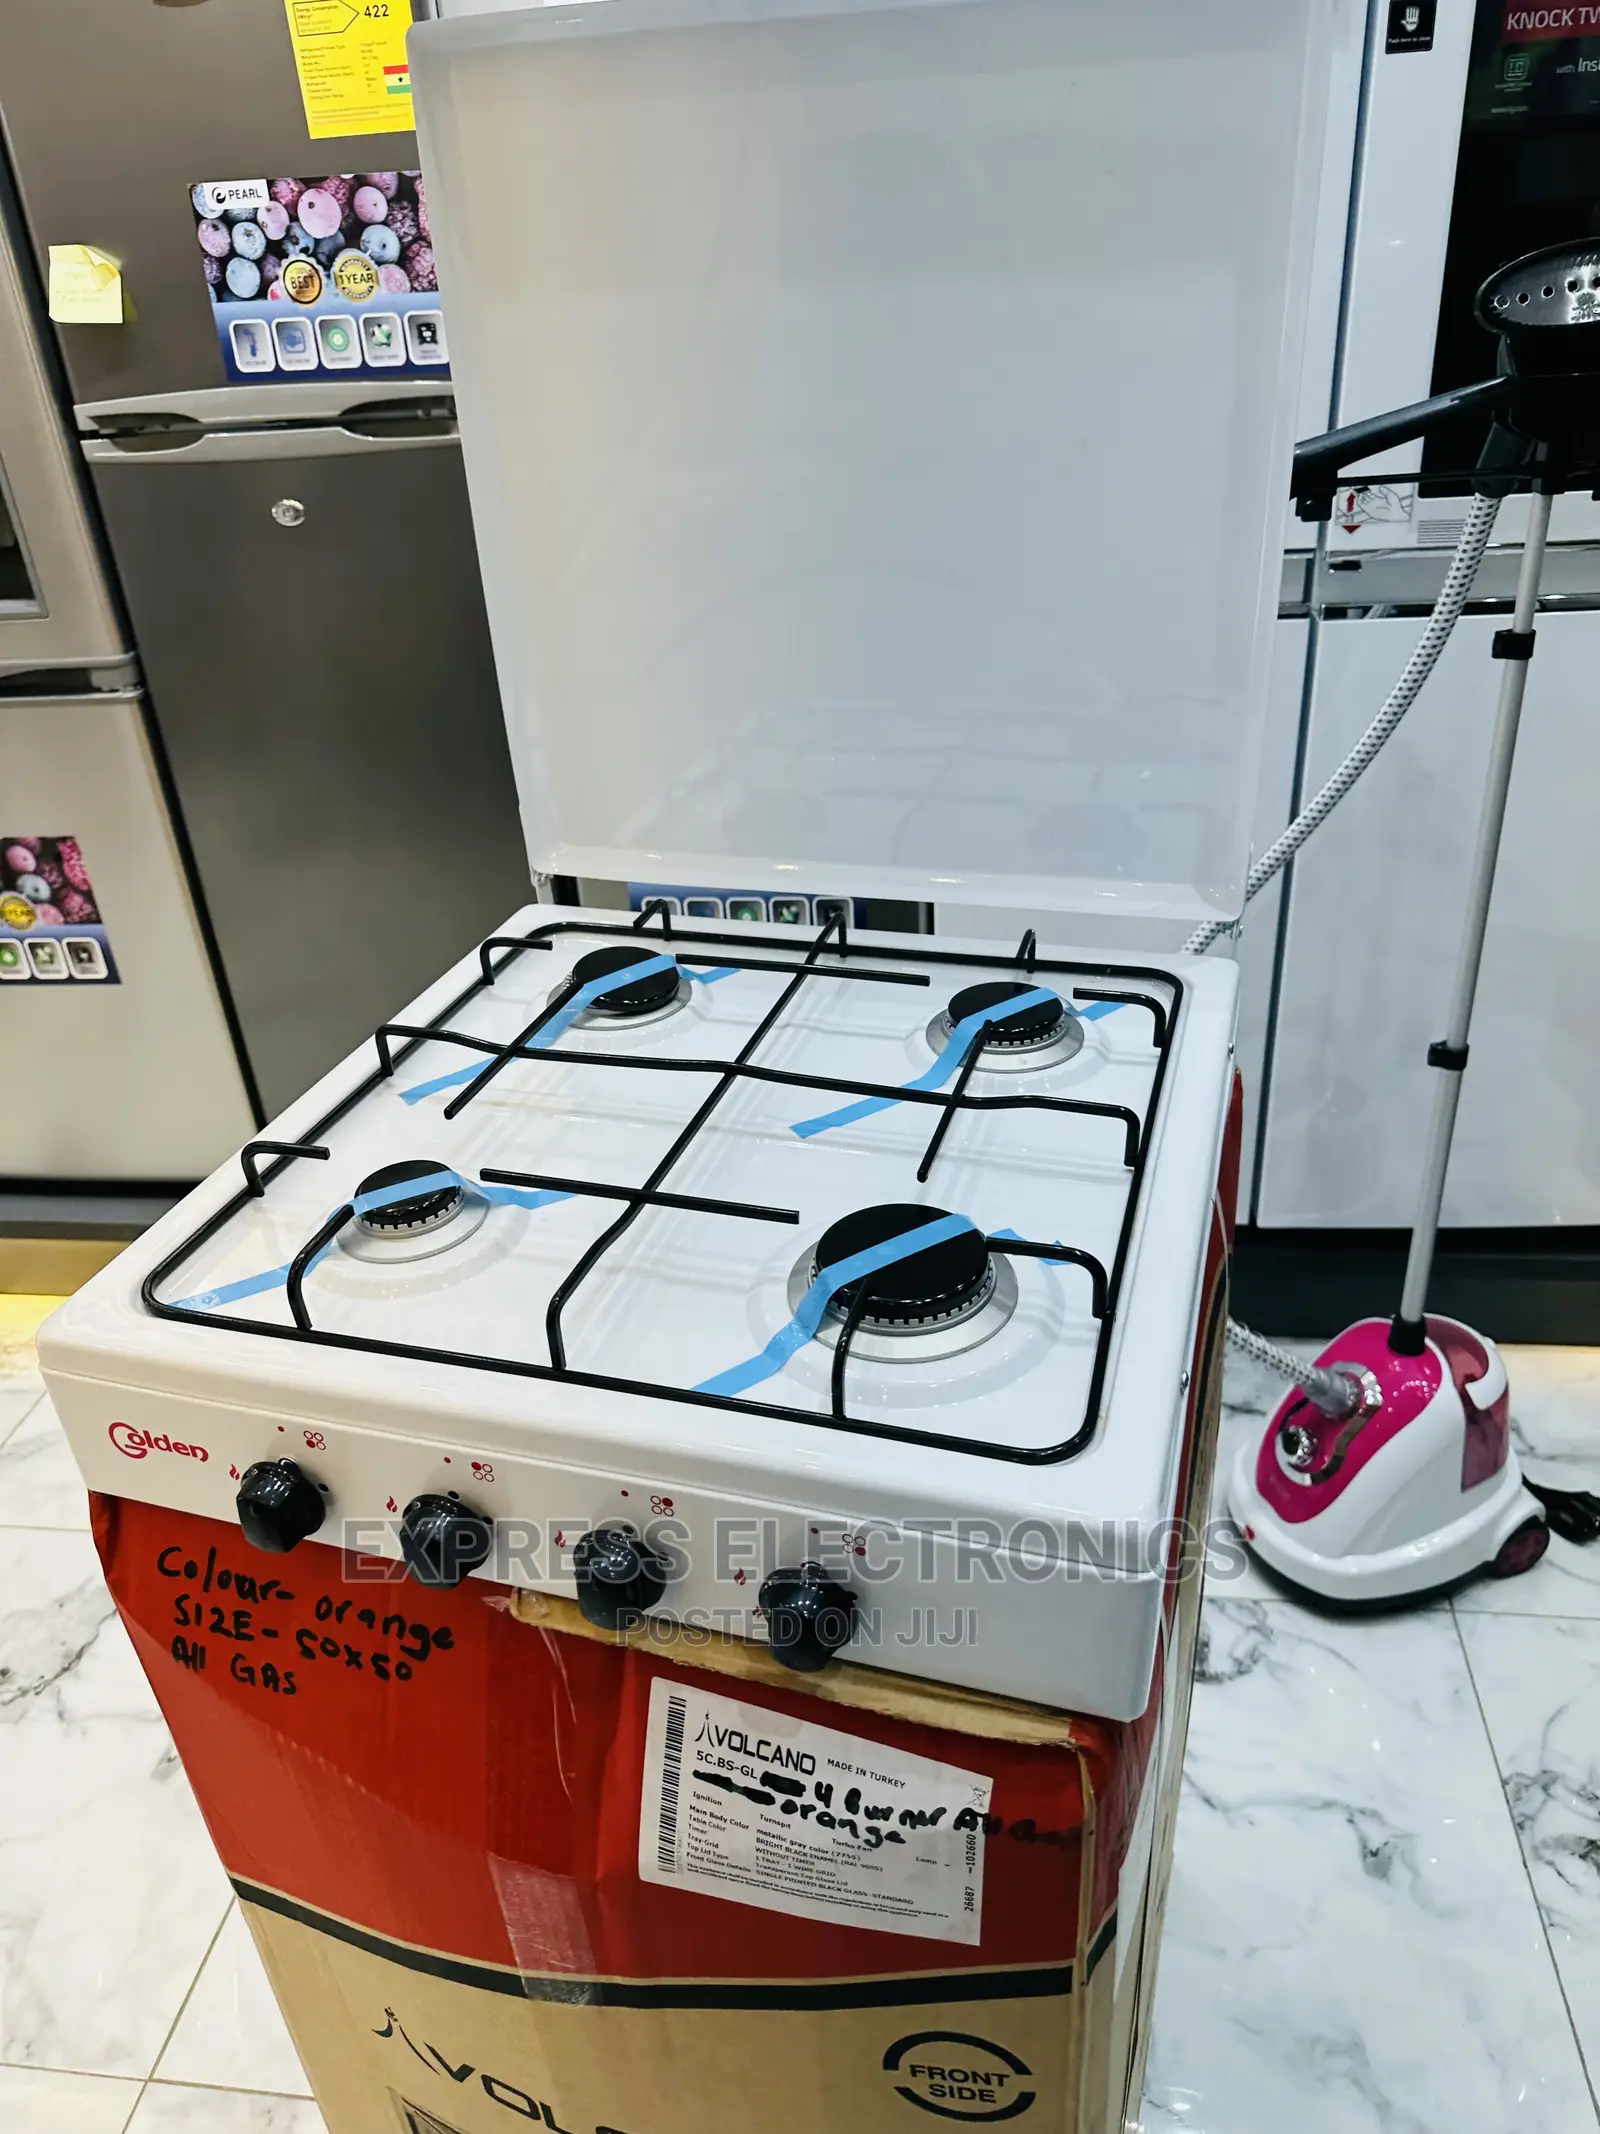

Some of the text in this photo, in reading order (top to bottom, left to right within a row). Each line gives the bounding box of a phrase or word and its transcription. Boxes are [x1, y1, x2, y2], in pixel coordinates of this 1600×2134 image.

[364, 4, 389, 18] 422
[1507, 8, 1575, 30] KNOCK
[1577, 57, 1600, 73] Ins
[228, 188, 263, 200] PEARL
[290, 274, 315, 290] BEST
[108, 1421, 209, 1463] Golden
[315, 1596, 455, 1662] orange
[715, 1725, 816, 1776] VOLCANO
[827, 1757, 906, 1790] MADE IN TURKEY
[692, 1791, 722, 1806] Ignition
[689, 1804, 750, 1830] Main Body Color
[689, 1814, 726, 1832] Table Color
[760, 1813, 791, 1829] Turnspit
[688, 1823, 708, 1835] Timer
[687, 1842, 699, 1852] Top
[700, 1847, 711, 1855] Lid
[756, 1837, 783, 1850] BRIGHT
[785, 1846, 808, 1857] BLACK
[809, 1845, 830, 1854] color
[832, 1837, 855, 1849] Turbo
[964, 1886, 975, 1912] 26687
[909, 2064, 1010, 2087] FRONT
[928, 2083, 997, 2103] SIDE
